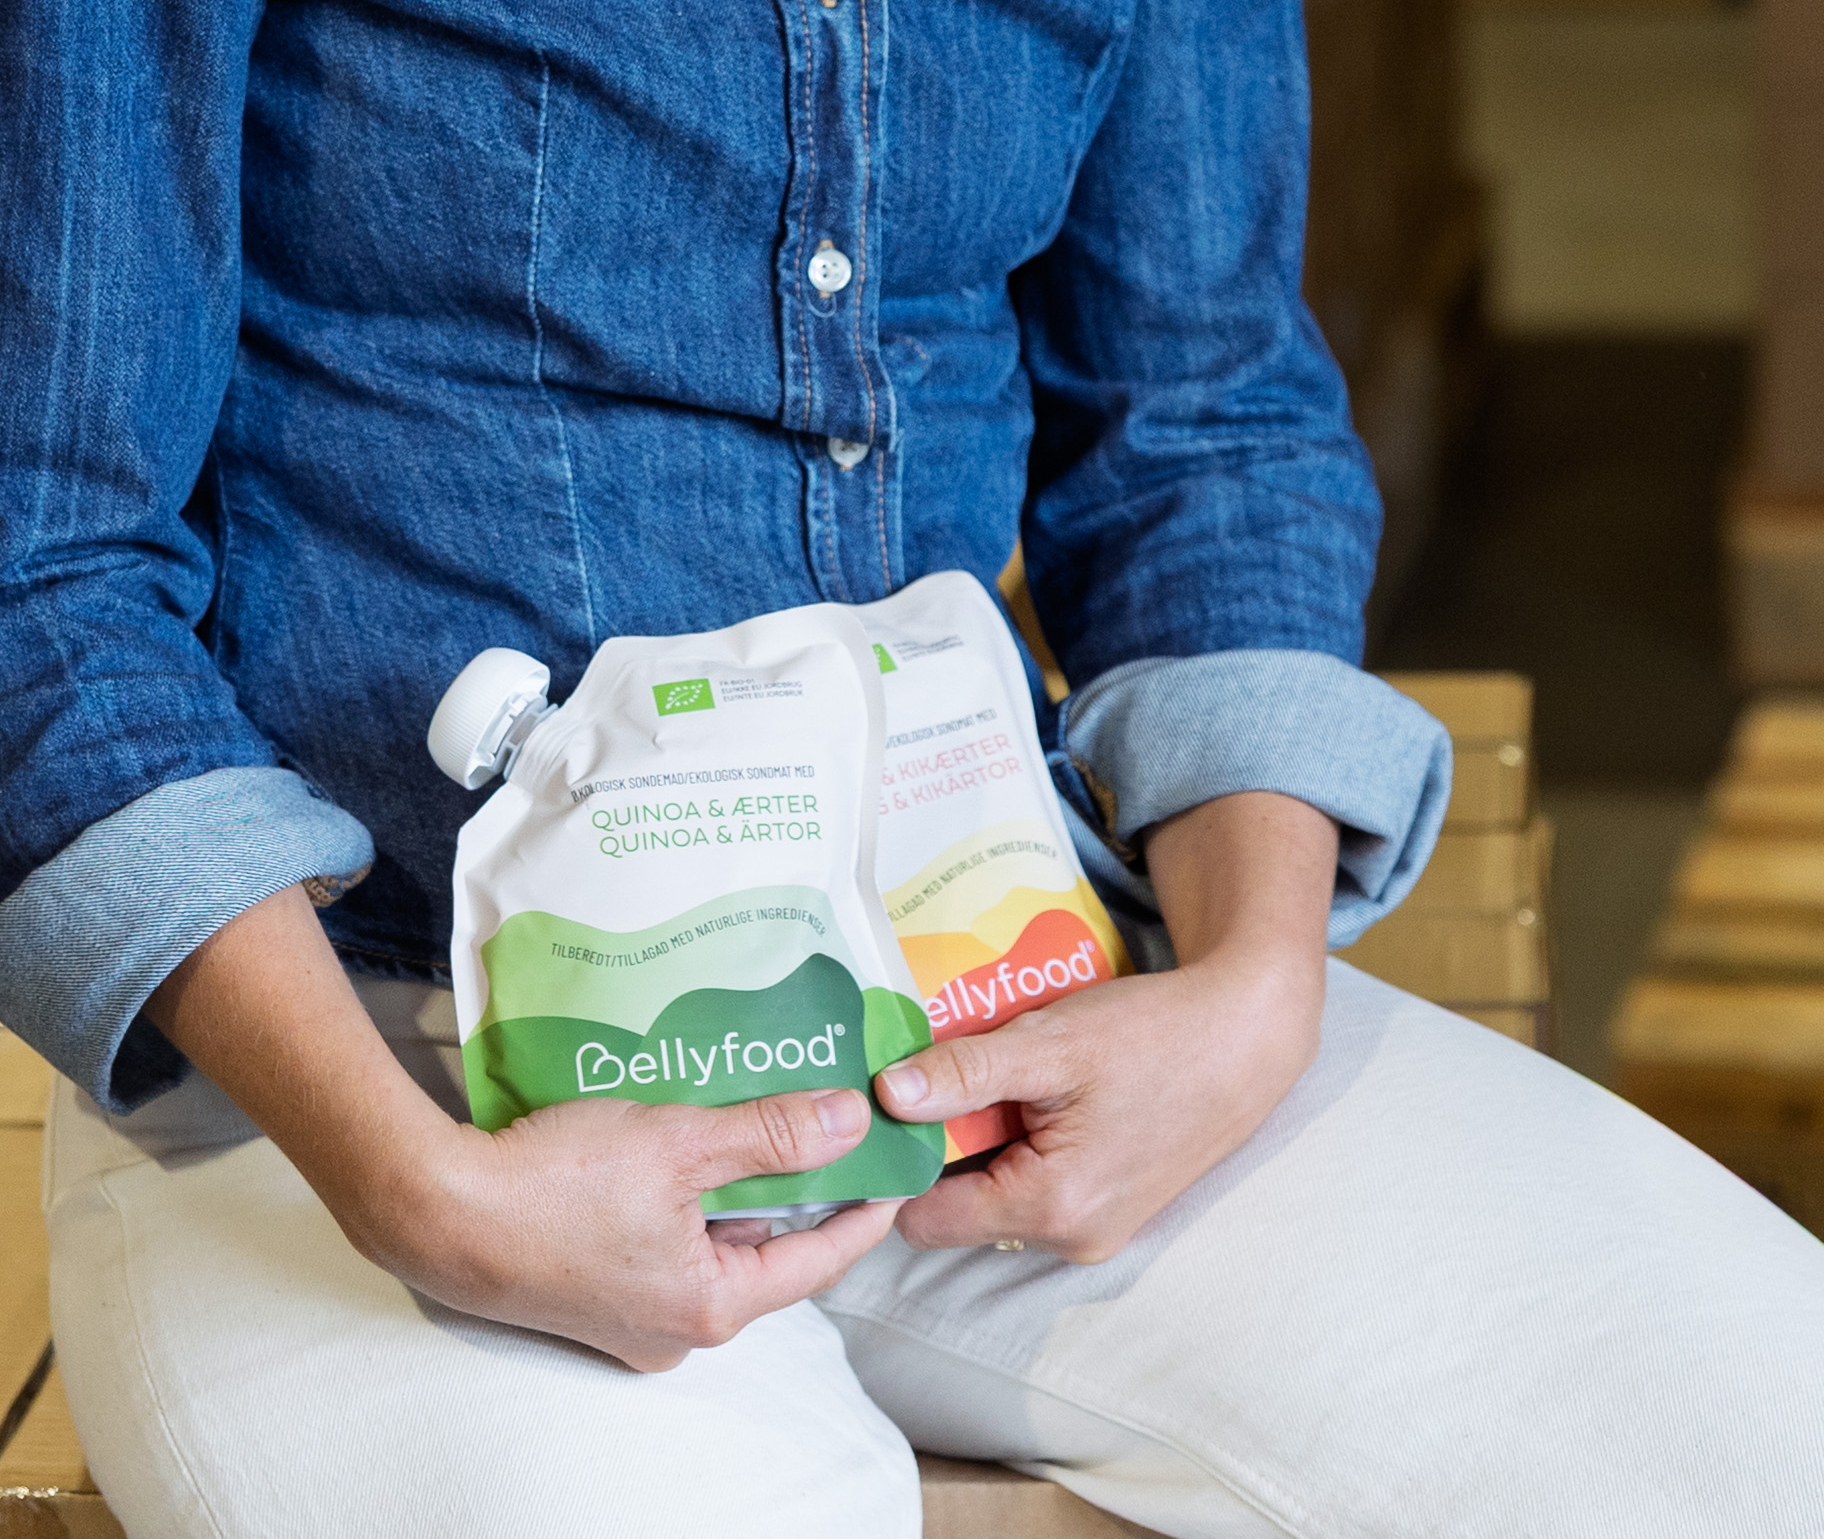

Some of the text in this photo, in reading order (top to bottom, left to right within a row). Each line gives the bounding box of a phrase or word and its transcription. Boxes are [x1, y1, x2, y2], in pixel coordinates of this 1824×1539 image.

[975, 708, 998, 723] MED
[897, 733, 1013, 780] KIKÆRTER
[628, 768, 745, 790] SONDEMAD/EKOLOGISK
[747, 766, 793, 781] SONDMAT
[795, 765, 815, 778] MED
[893, 791, 909, 810] &
[912, 757, 1024, 806] KIKÄRTOR
[591, 794, 819, 832] QUINOA & ÆRTER
[599, 819, 823, 858] QUINOA & ÄRTOR
[550, 907, 827, 968] TILBEREDT/TILLAGAD MED NATURLIGE INGREDIENSER
